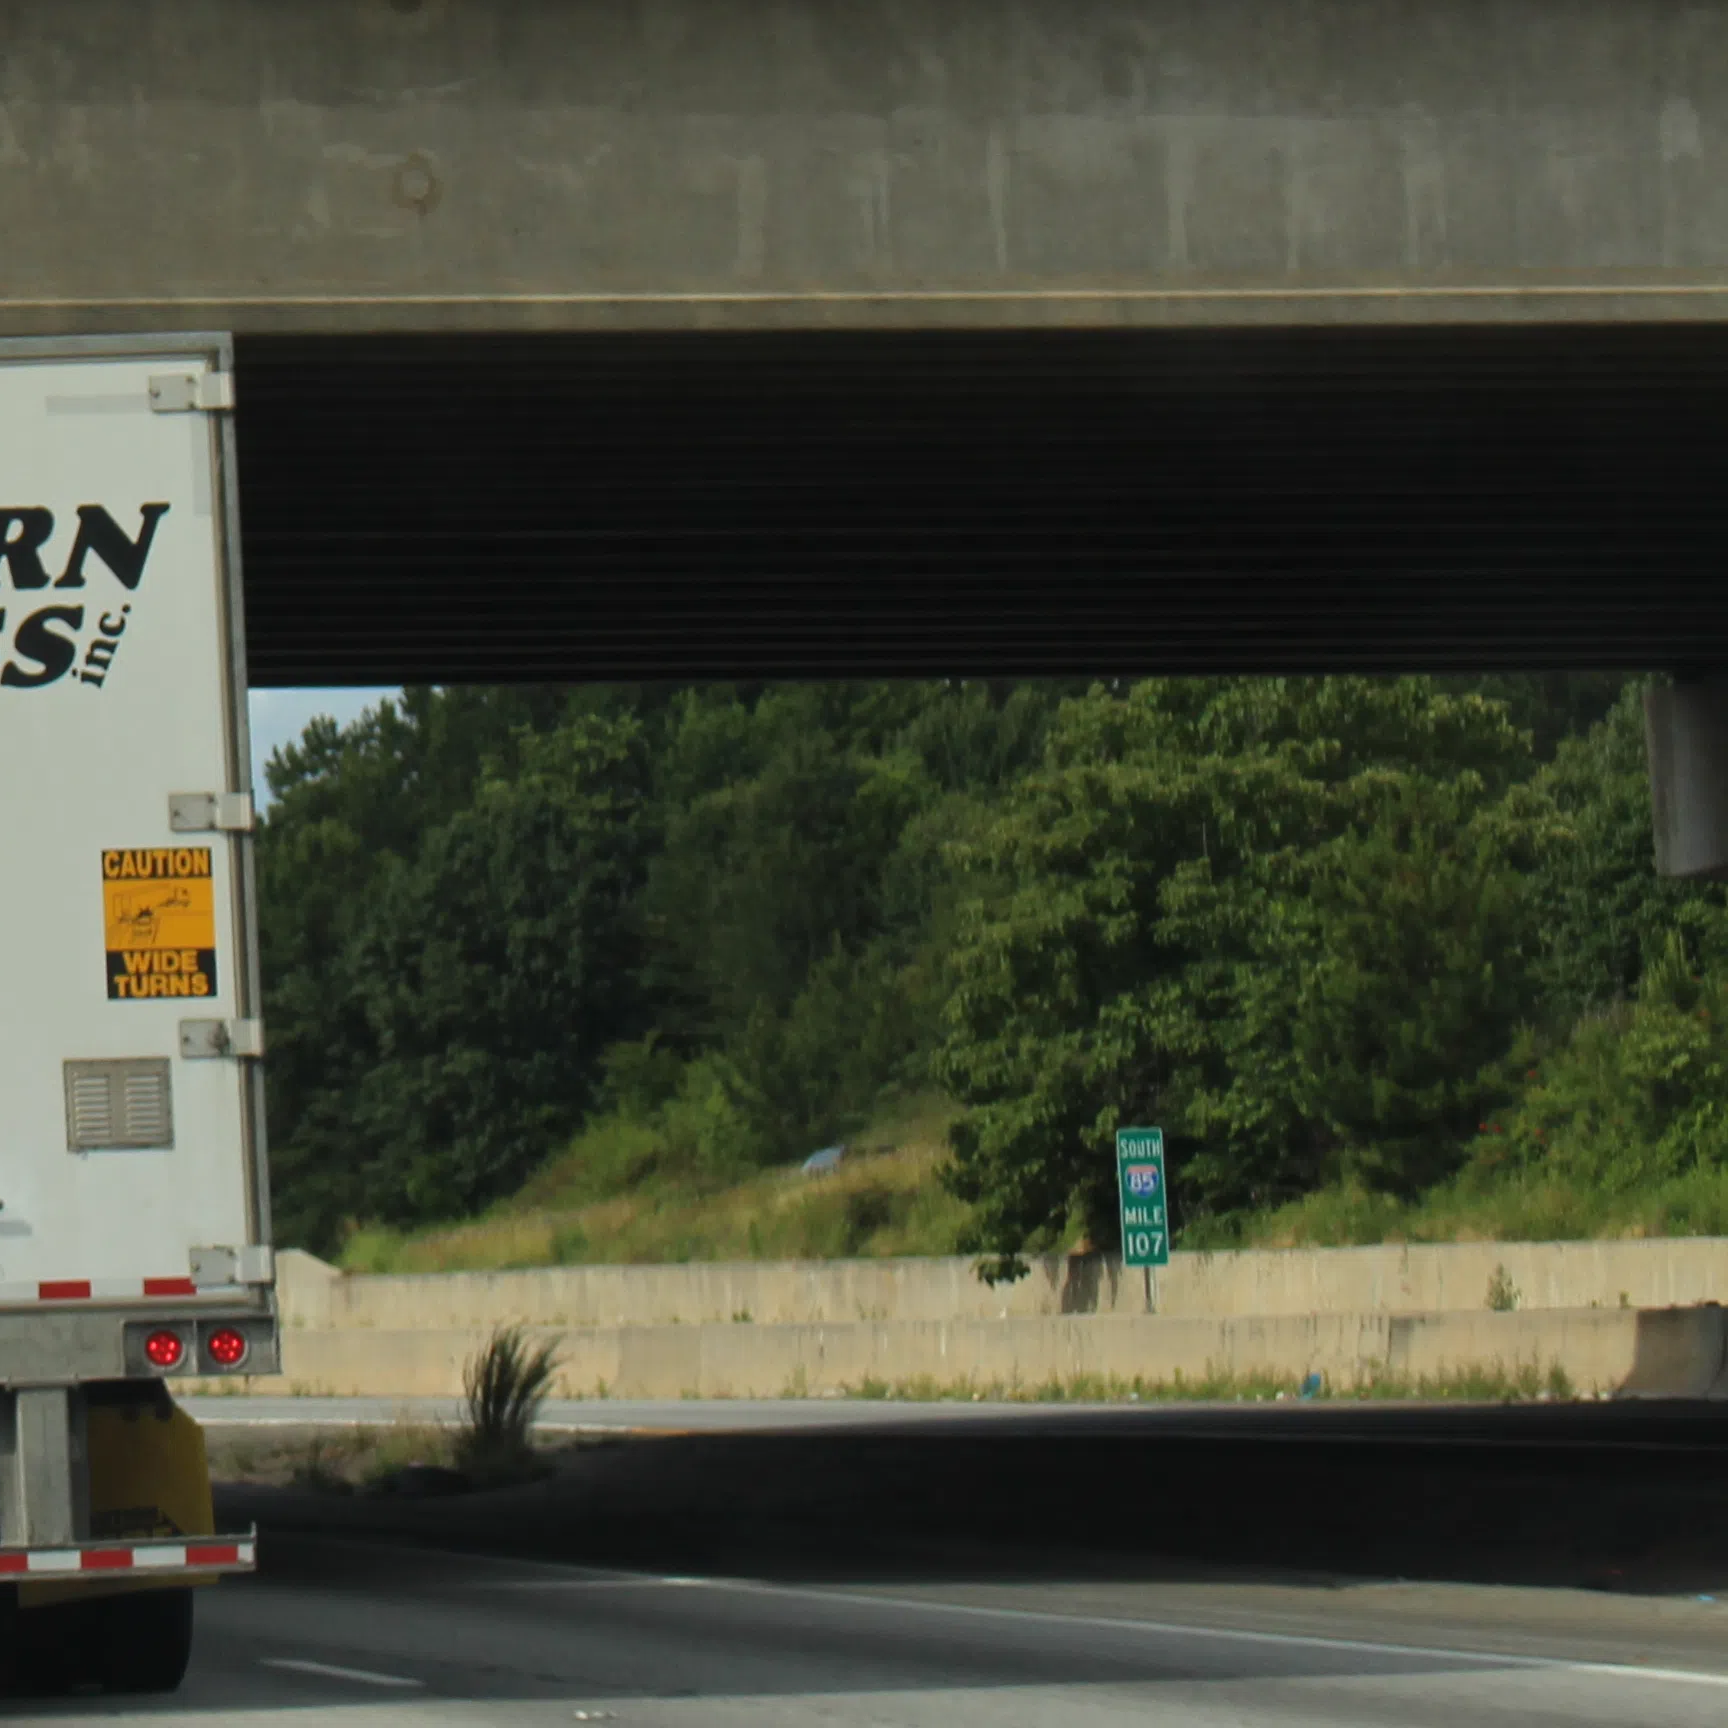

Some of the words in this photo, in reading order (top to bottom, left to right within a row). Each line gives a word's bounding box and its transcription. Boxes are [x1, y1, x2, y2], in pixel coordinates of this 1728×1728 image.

[73, 602, 132, 690] inc.
[104, 848, 210, 879] CAUTION
[122, 950, 200, 974] WIDE
[114, 972, 210, 997] TURNS
[1120, 1138, 1160, 1159] SOUTH
[1130, 1172, 1155, 1191] 85
[1125, 1205, 1163, 1225] MILE
[1127, 1231, 1163, 1257] 107
